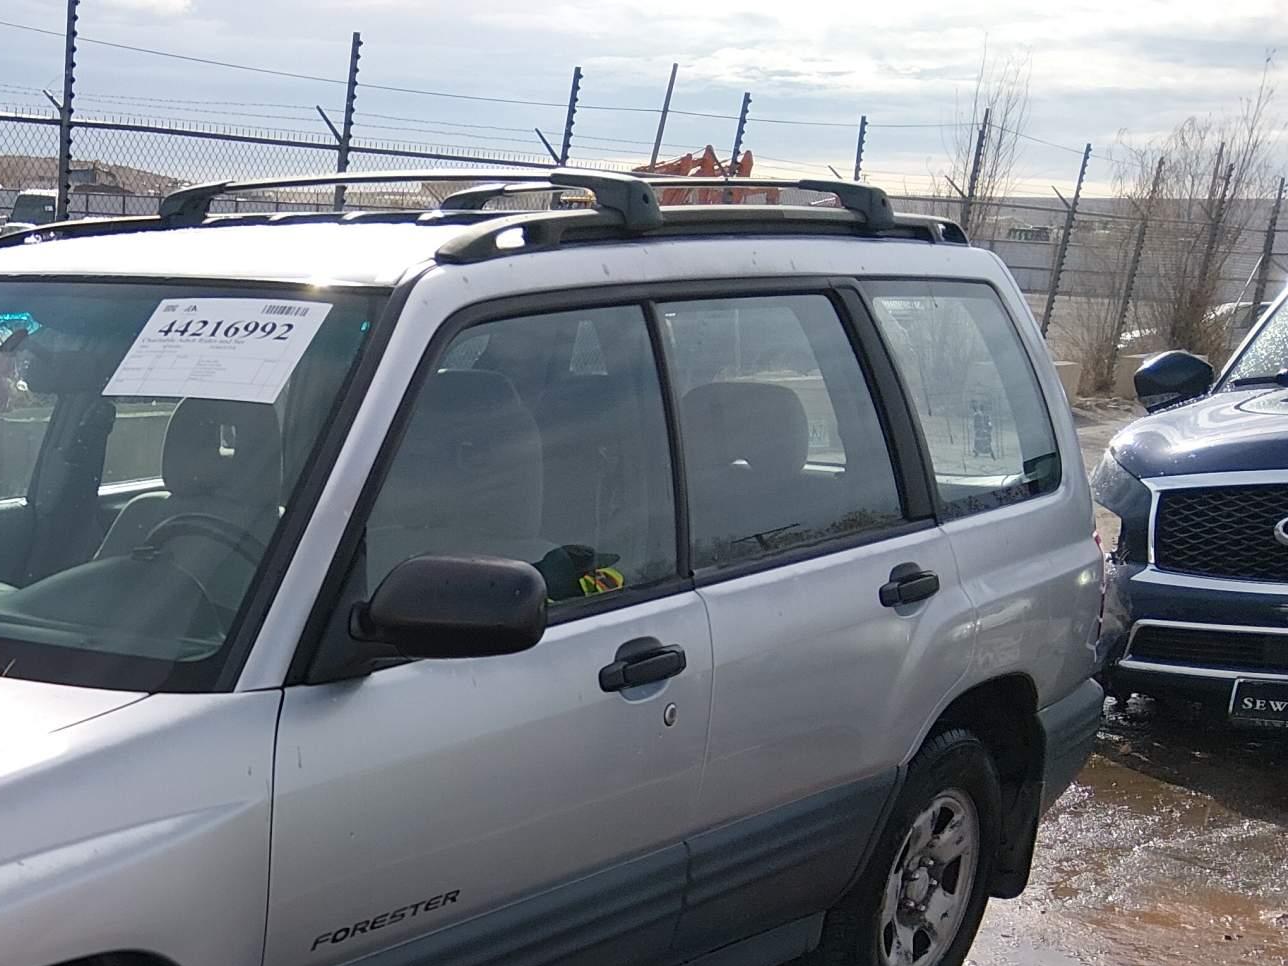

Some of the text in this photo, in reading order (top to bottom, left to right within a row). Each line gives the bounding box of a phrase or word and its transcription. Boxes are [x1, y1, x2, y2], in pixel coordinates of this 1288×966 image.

[158, 319, 294, 340] 44216992
[1241, 697, 1288, 712] SEW
[310, 889, 460, 952] FORESTER
